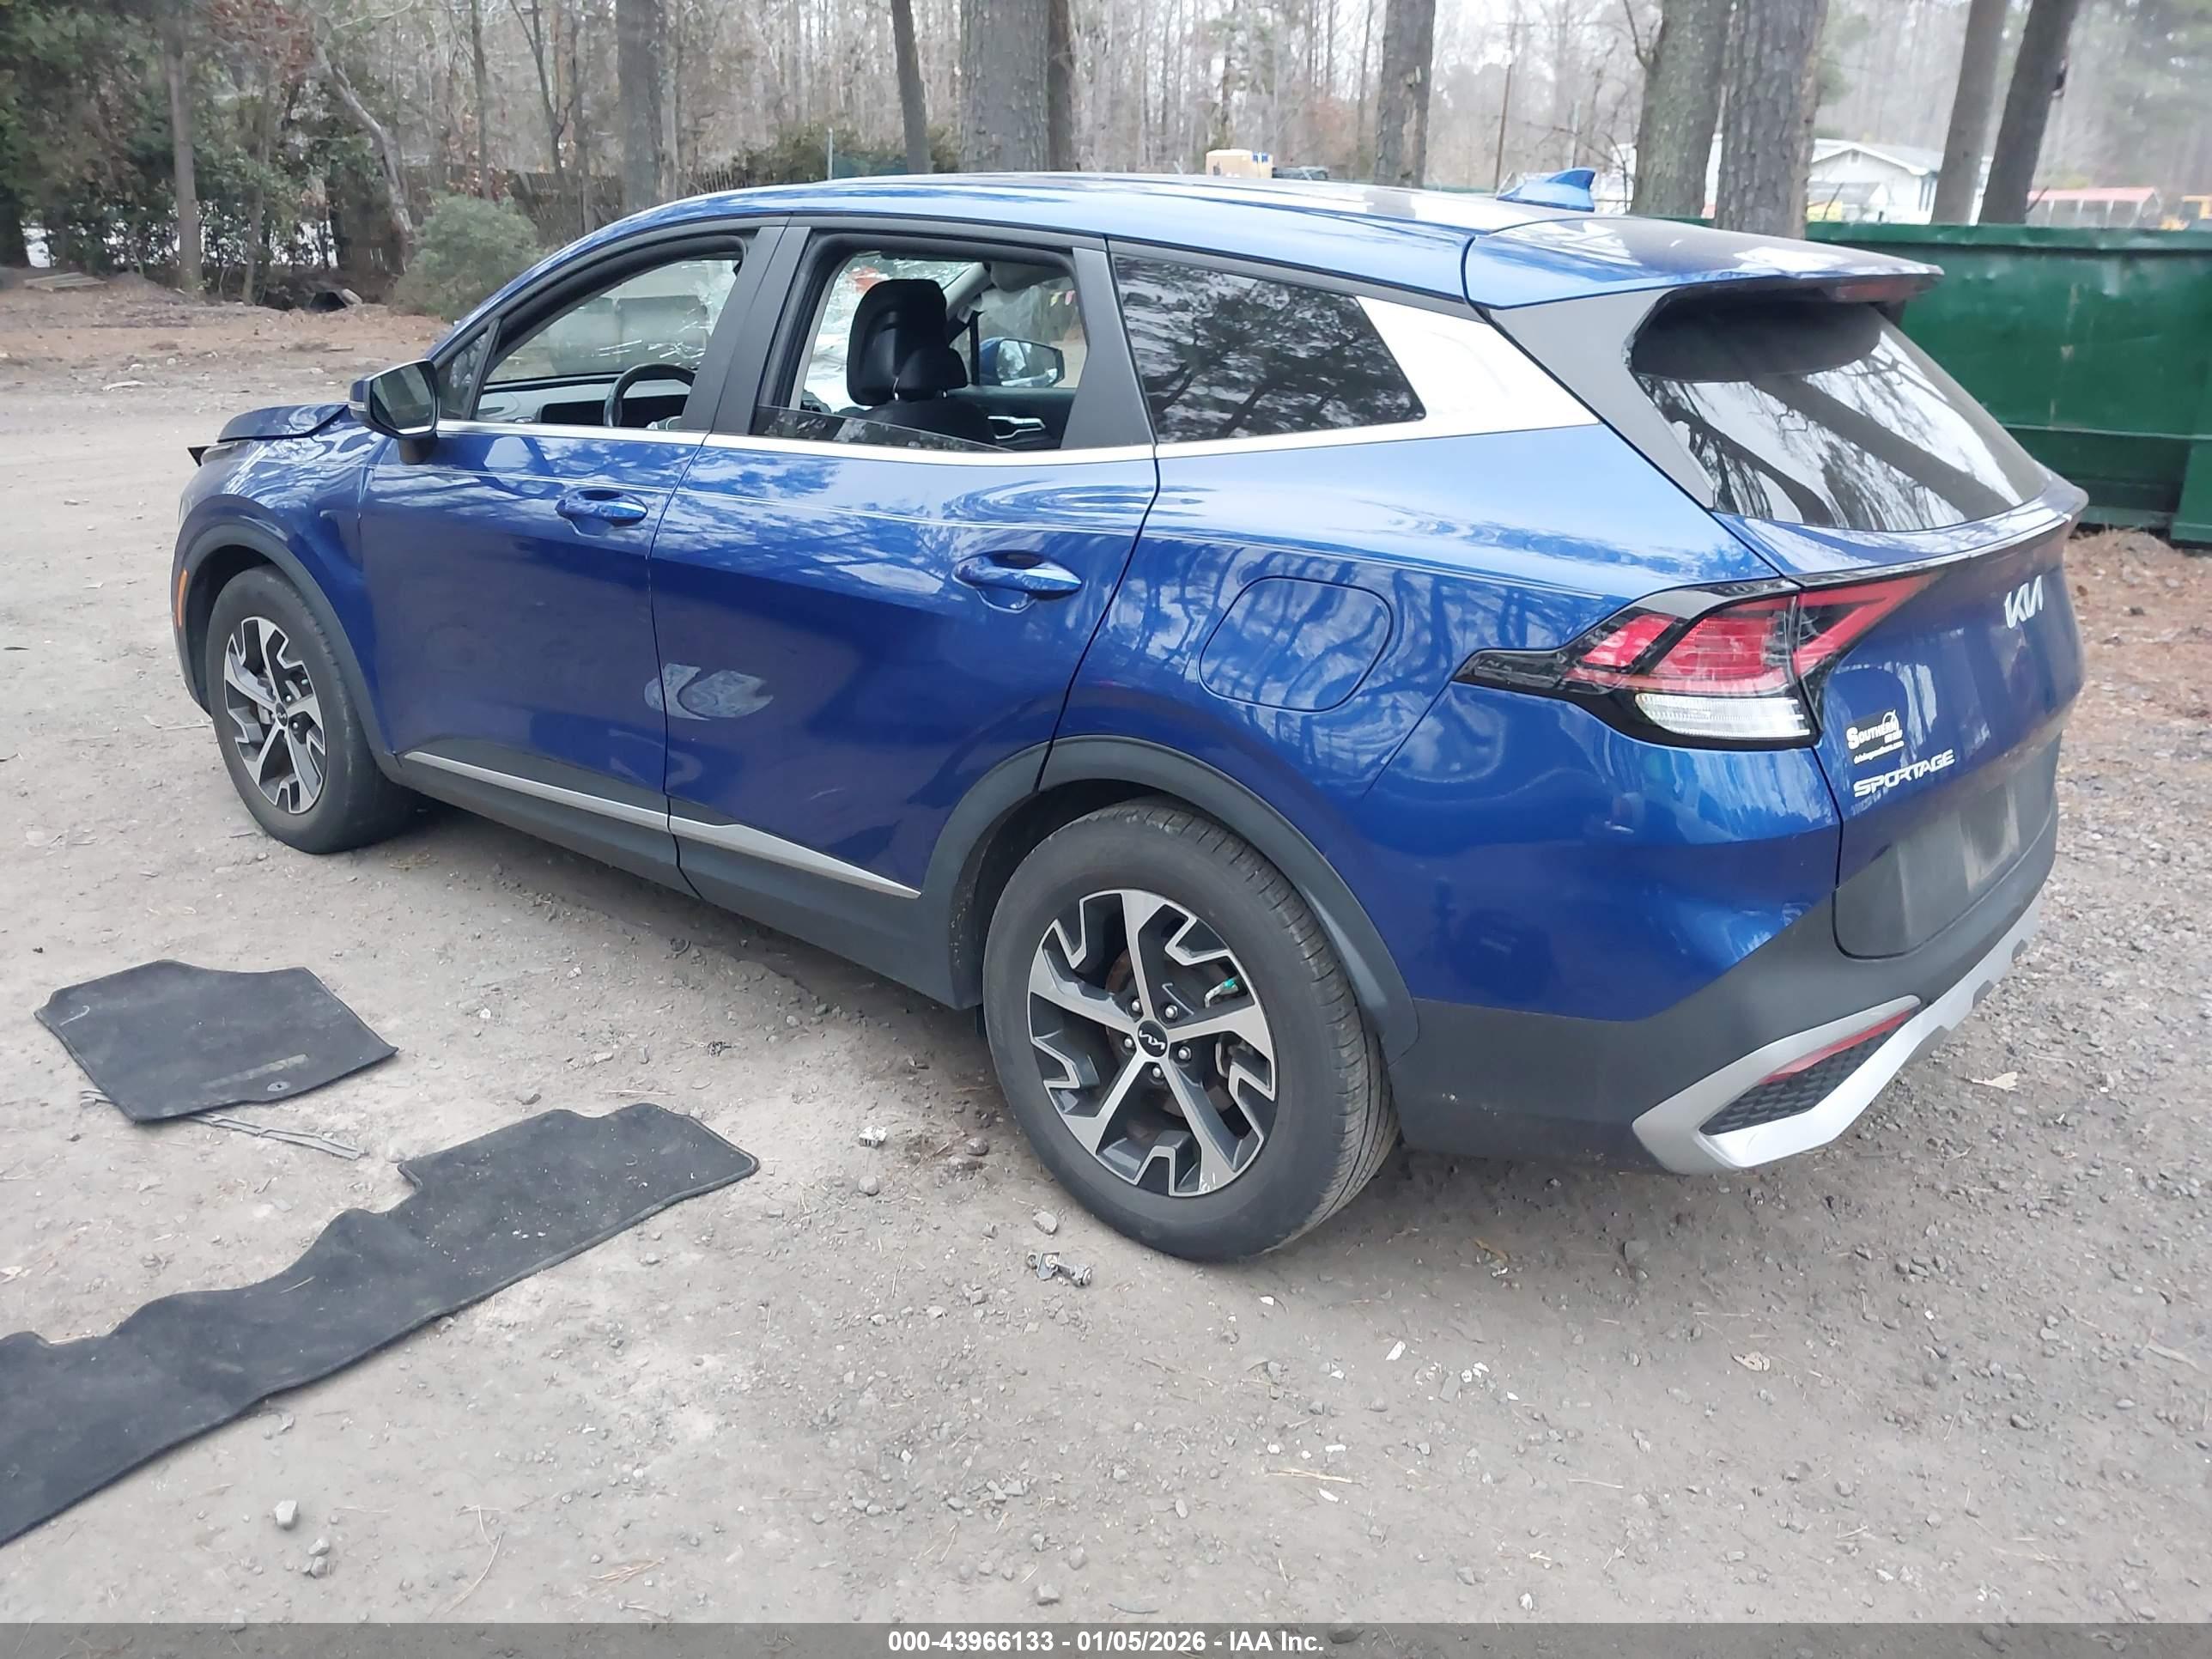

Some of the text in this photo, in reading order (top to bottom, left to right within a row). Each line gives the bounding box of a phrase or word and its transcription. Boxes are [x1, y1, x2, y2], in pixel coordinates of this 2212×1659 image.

[2003, 574, 2044, 629] KIA
[1846, 720, 1899, 750] SOUTHERN
[1853, 749, 1955, 798] SPORTAGE
